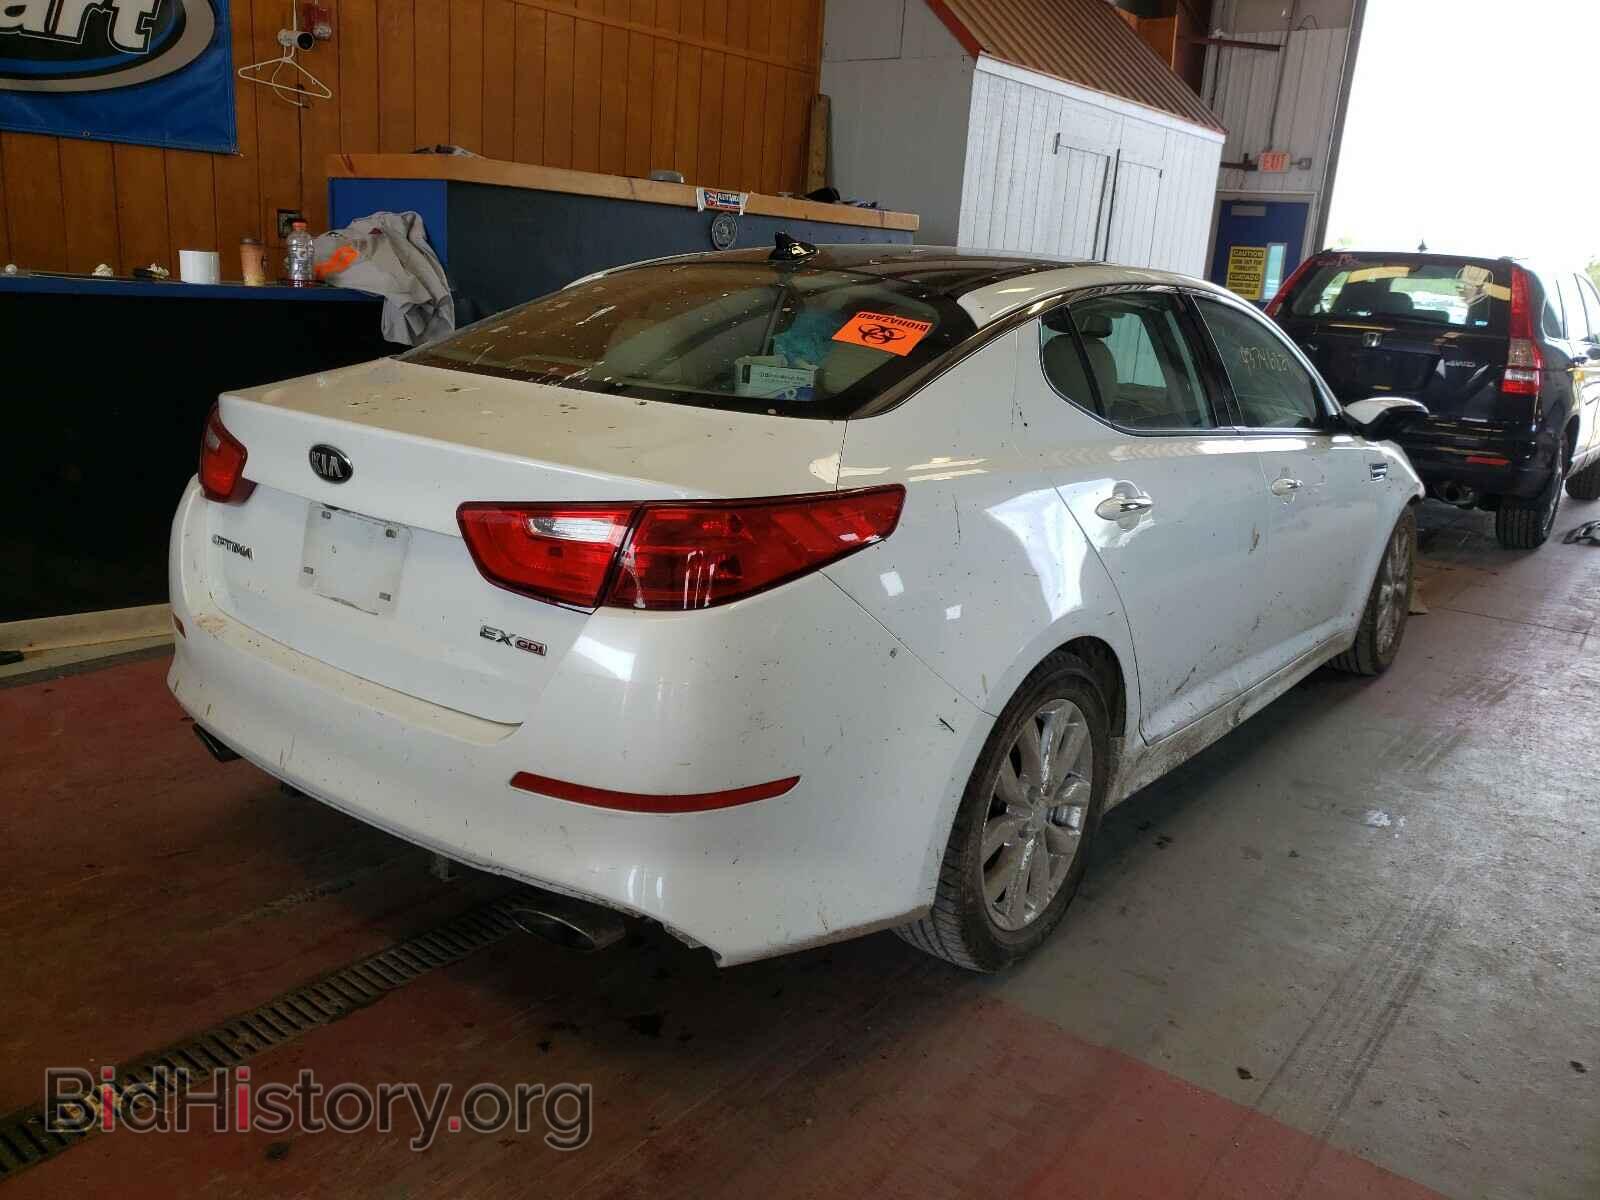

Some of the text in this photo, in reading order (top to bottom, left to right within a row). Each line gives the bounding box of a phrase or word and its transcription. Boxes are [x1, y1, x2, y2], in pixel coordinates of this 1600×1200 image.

[858, 312, 929, 331] BIOHAZARD
[311, 450, 344, 478] KIA
[211, 533, 254, 561] OPTIMA
[480, 625, 516, 647] EX
